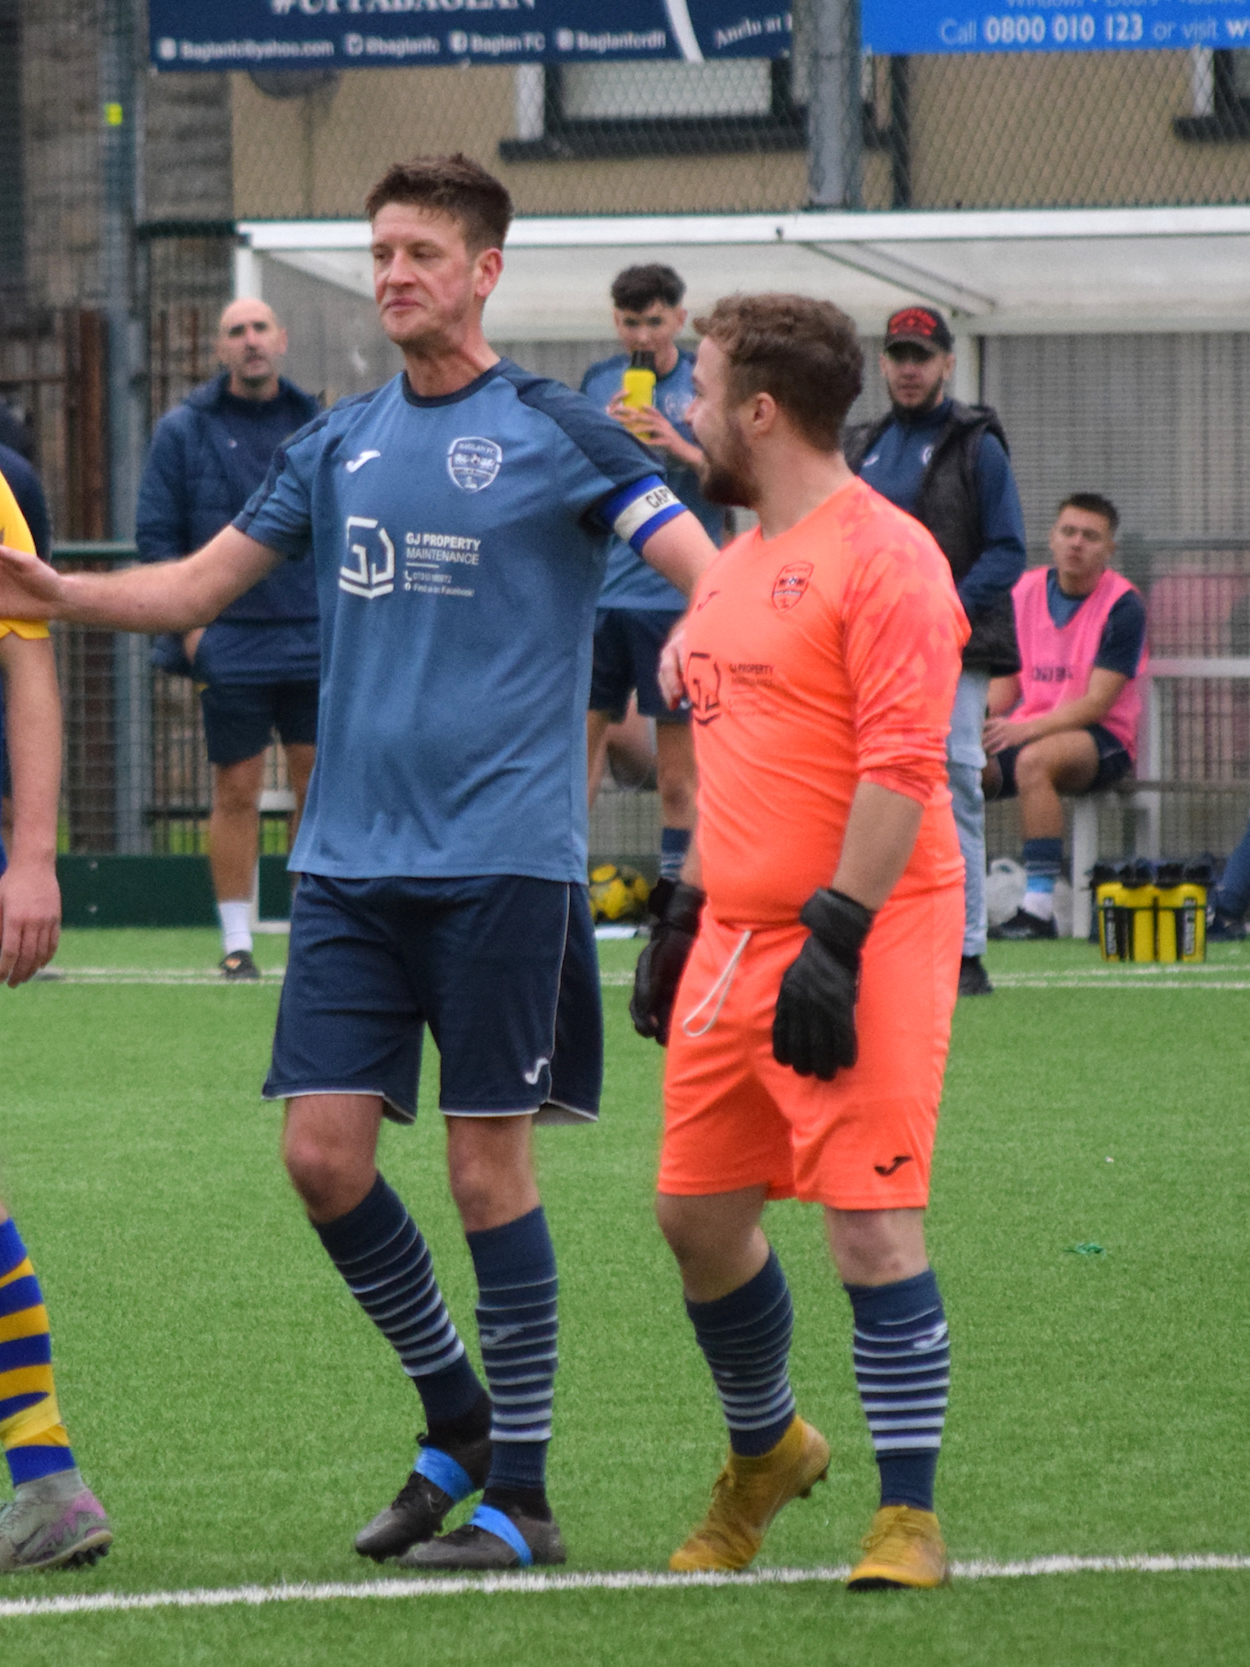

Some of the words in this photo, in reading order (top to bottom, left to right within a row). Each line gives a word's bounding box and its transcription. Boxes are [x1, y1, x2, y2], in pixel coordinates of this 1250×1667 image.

[941, 17, 977, 44] Call
[984, 14, 1046, 43] 0800
[1053, 14, 1095, 42] 010
[1105, 12, 1143, 41] 123
[1153, 21, 1176, 40] or
[1181, 17, 1218, 40] visit
[406, 532, 421, 546] GJ
[423, 533, 481, 552] PROPERTY
[406, 547, 480, 566] MAINTENANCE
